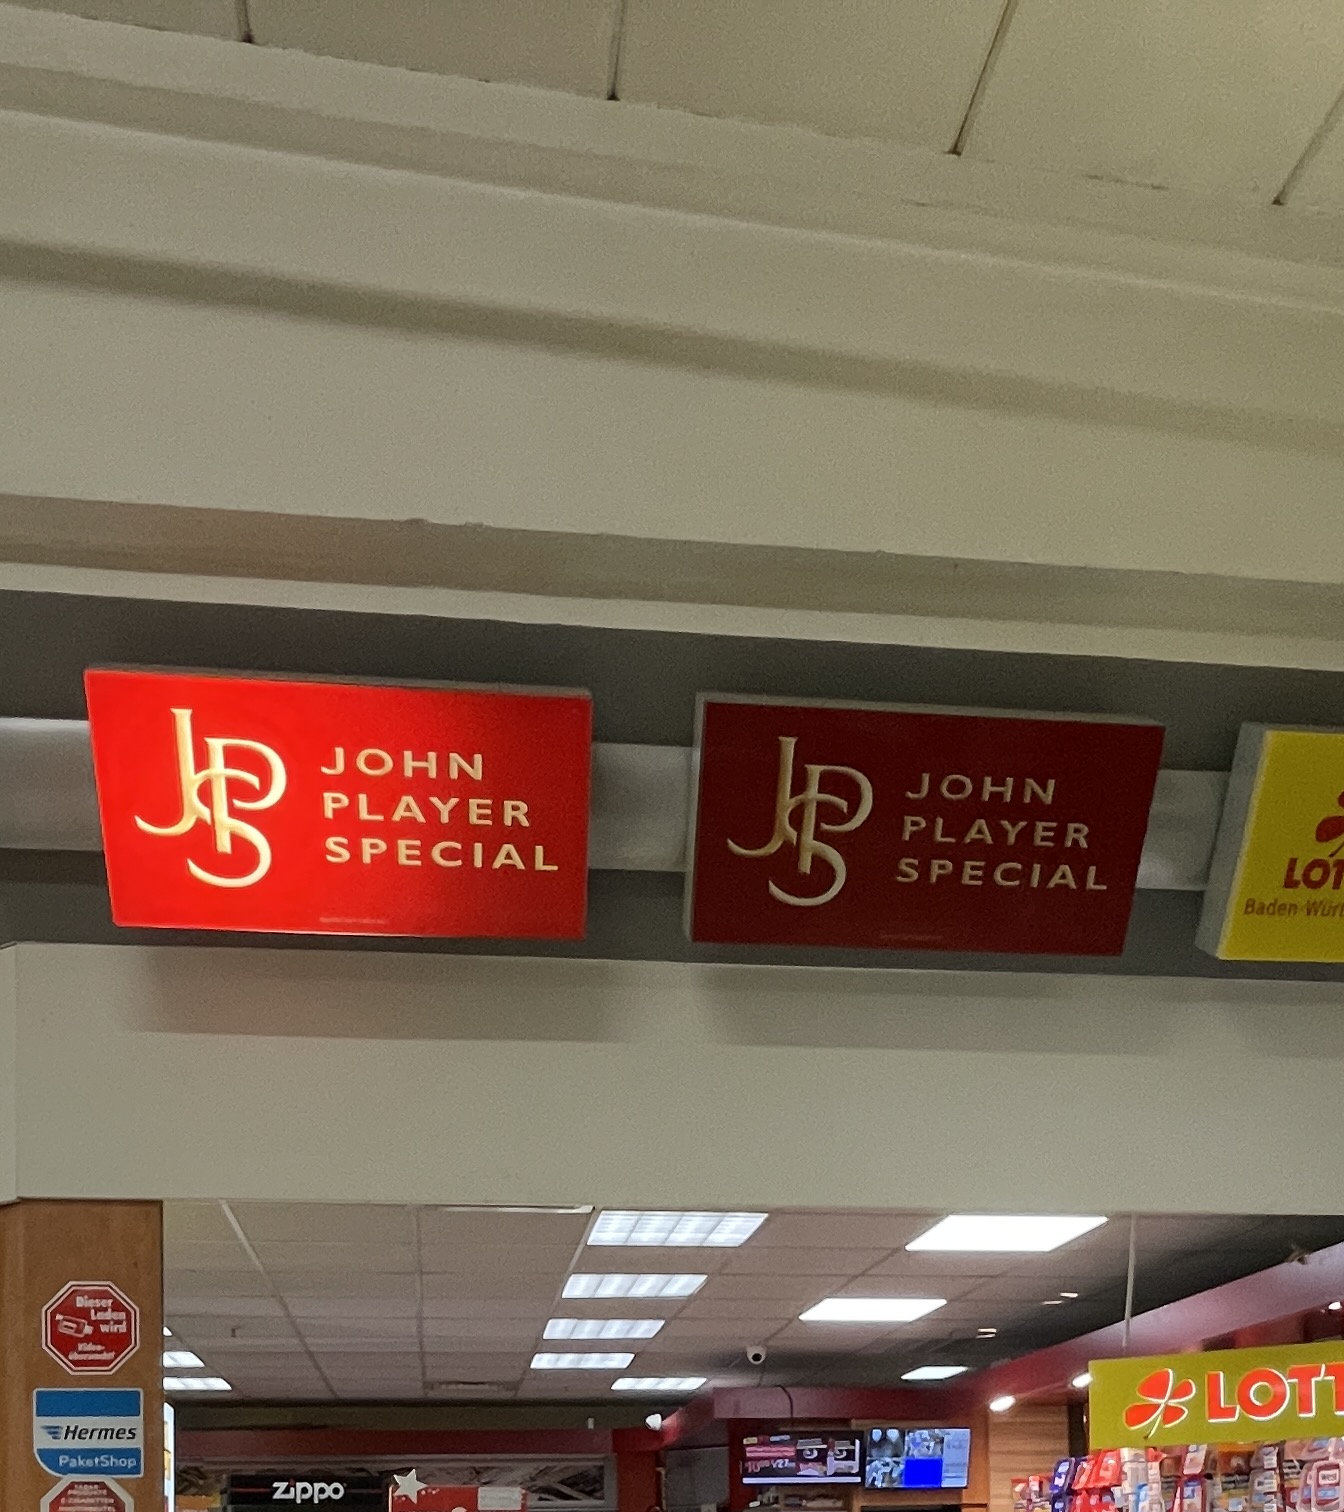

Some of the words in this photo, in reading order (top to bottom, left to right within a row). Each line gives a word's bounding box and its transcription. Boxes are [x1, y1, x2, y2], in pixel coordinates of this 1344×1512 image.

[321, 746, 484, 782] JOHN
[904, 772, 1057, 806] JOHN
[323, 791, 531, 828] PLAYER
[901, 815, 1091, 850] PLAYER
[325, 836, 560, 873] SPECIAL
[895, 857, 1109, 893] SPECIAL
[75, 1295, 113, 1308] Dieser
[90, 1307, 126, 1320] Laden
[99, 1320, 127, 1333] wird
[63, 1424, 138, 1441] Hermes
[58, 1454, 137, 1470] PaketShop
